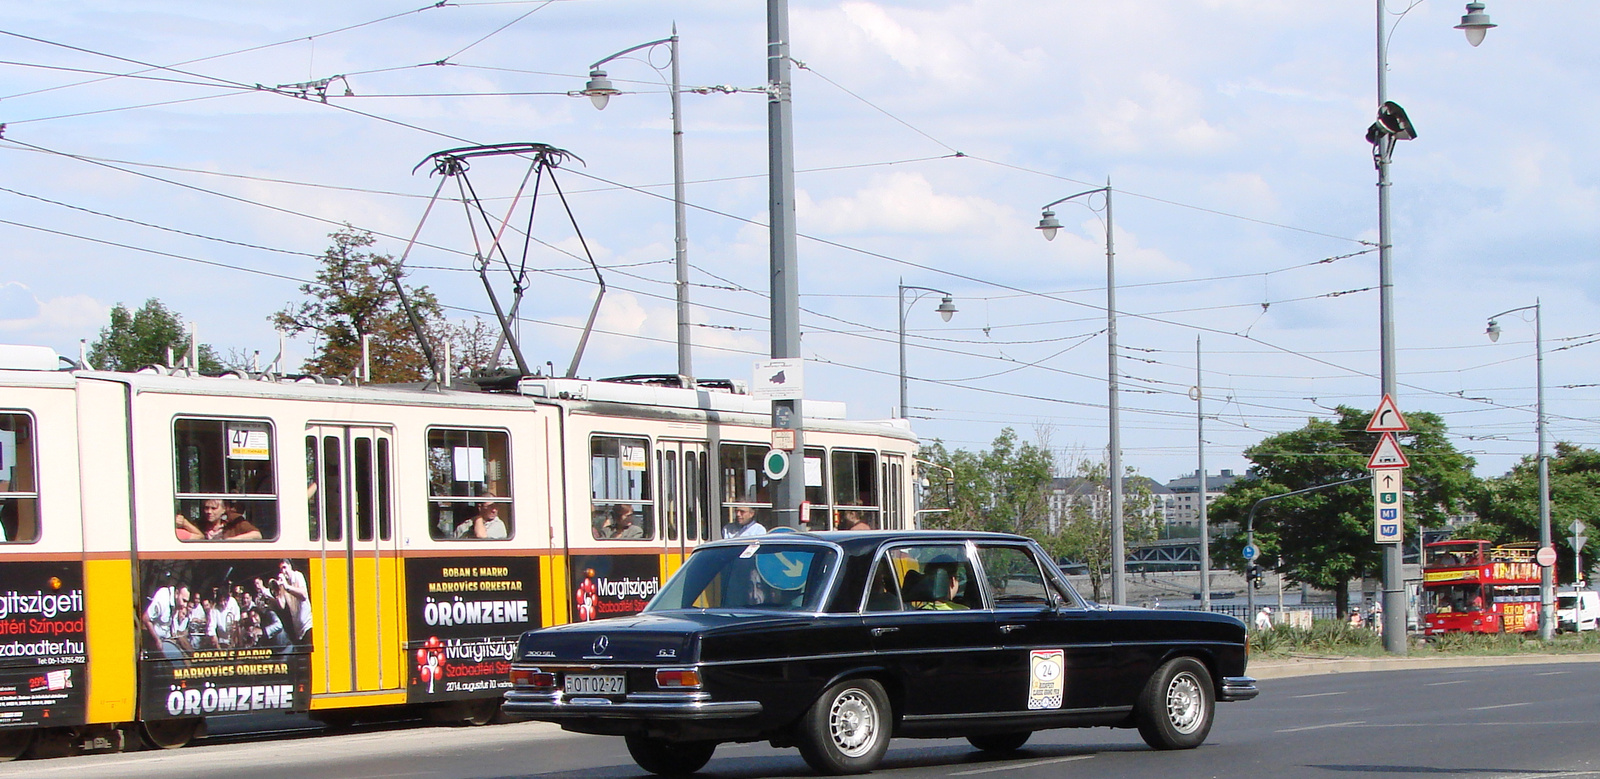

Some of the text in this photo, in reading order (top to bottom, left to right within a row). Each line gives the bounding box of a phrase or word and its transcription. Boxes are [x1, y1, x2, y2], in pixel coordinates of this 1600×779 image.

[232, 430, 249, 447] 47
[623, 445, 633, 460] 47
[1385, 494, 1391, 502] 6
[1382, 510, 1394, 518] M1
[1382, 526, 1395, 534] M7
[443, 567, 471, 577] BOBAN
[480, 567, 508, 577] MARKO
[480, 581, 522, 591] ORKESTAR
[598, 577, 658, 600] Margitszigeti
[425, 596, 528, 626] ÖRÖMZENE
[29, 617, 84, 636] Színpad
[236, 663, 288, 675] ORKESTAR
[446, 662, 494, 677] Szabadtéri
[1042, 664, 1052, 677] 24
[574, 676, 590, 692] OT
[592, 676, 624, 692] 02-27
[167, 681, 293, 716] ÖRÖMZENE
